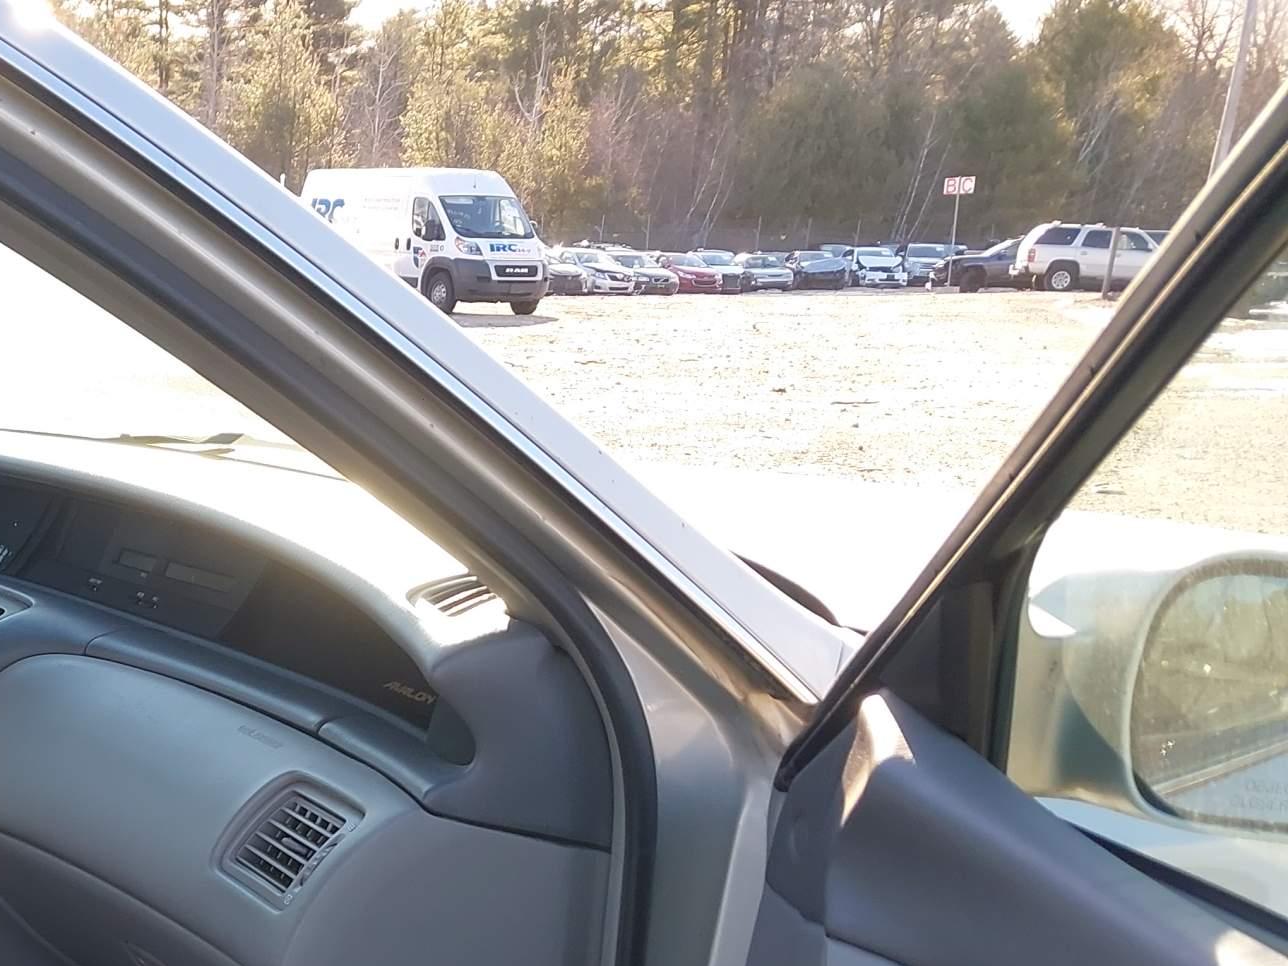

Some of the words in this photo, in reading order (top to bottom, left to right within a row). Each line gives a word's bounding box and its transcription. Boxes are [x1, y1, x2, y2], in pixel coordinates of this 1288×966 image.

[946, 178, 957, 193] B
[962, 177, 974, 193] C
[489, 243, 518, 253] IRC
